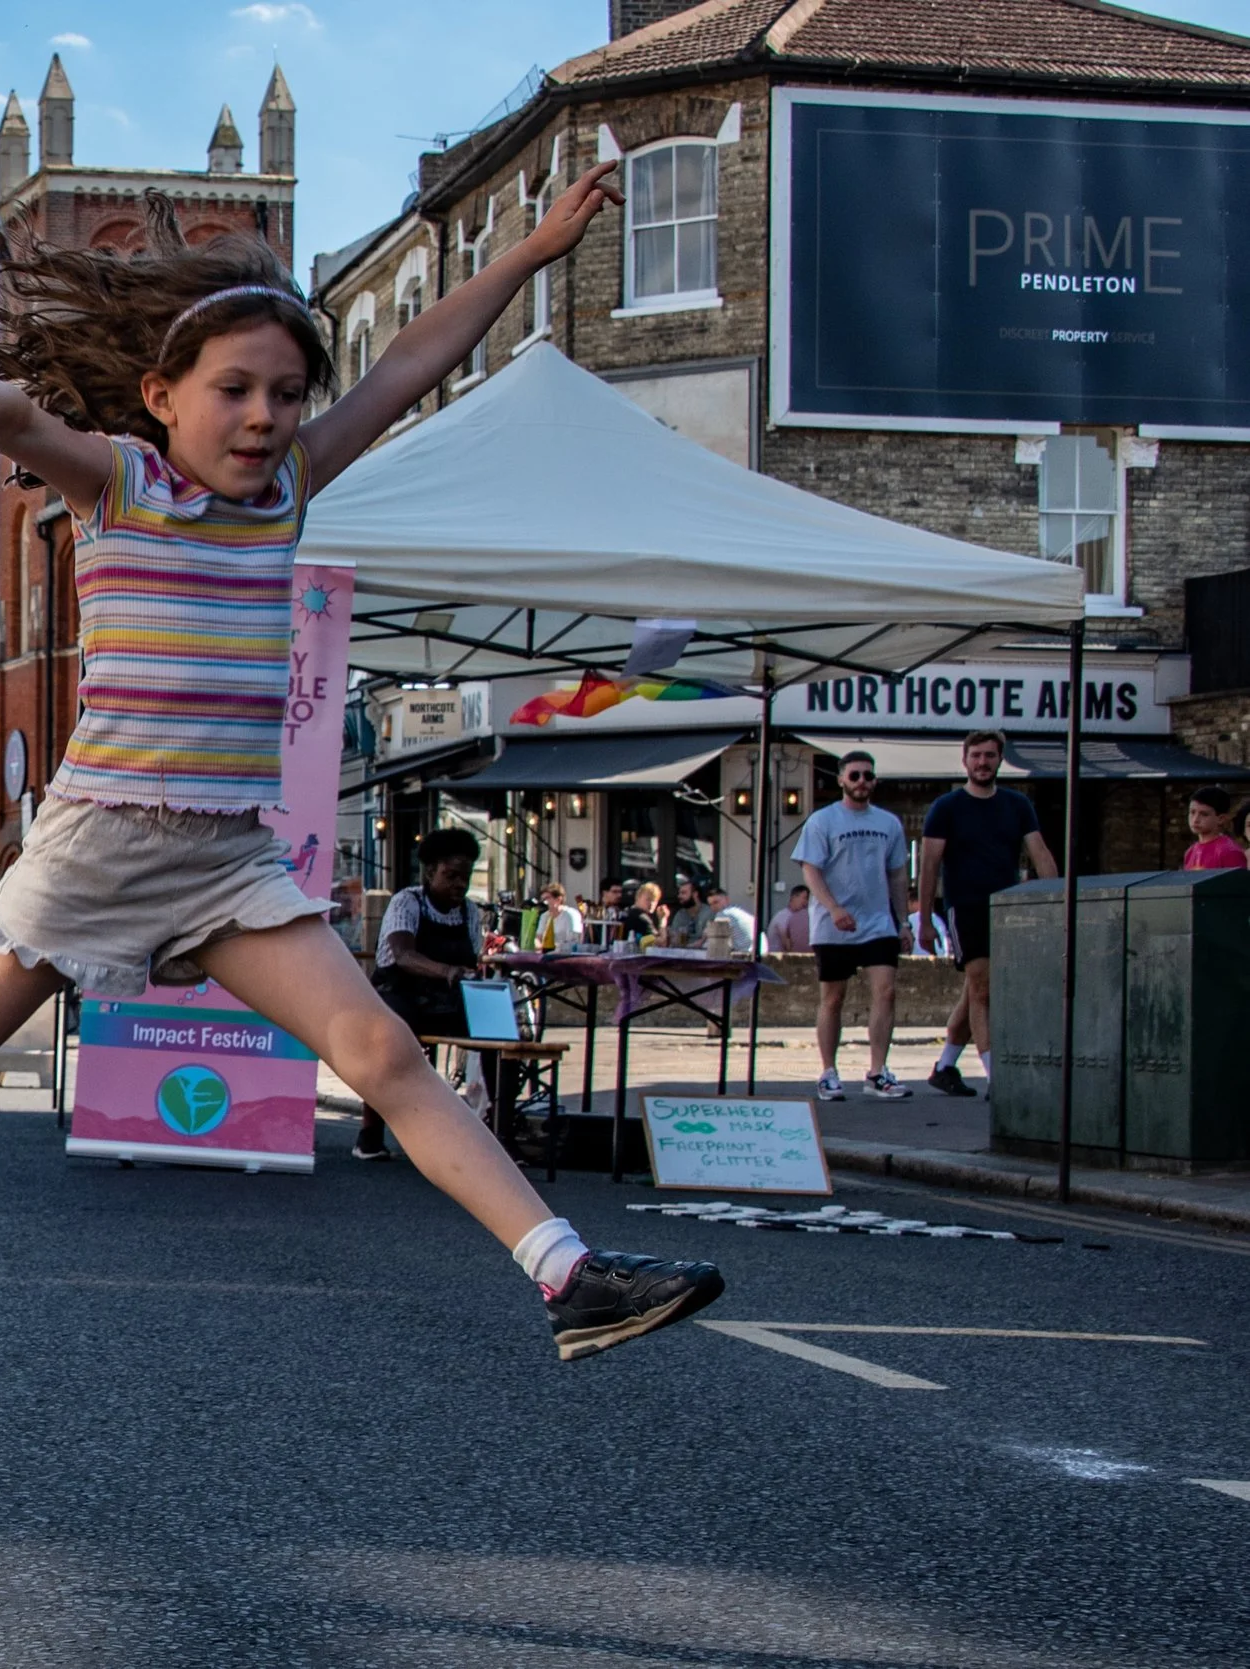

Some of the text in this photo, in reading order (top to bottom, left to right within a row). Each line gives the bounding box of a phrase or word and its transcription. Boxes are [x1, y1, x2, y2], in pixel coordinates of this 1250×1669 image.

[968, 208, 1184, 295] PRIME
[1020, 272, 1136, 294] PENDLETON
[1052, 329, 1108, 343] PROPERTY
[1110, 331, 1155, 345] SERVICE
[807, 675, 1024, 717] NORTHCOTE
[409, 702, 456, 713] NORTHCOTE
[421, 713, 445, 724] ARMS
[133, 1023, 274, 1051] Impact Festival
[652, 1099, 775, 1121] SUPERHERO
[729, 1121, 777, 1133] MASK
[657, 1137, 757, 1152] FACEPAINT
[700, 1153, 781, 1168] GLITTER
